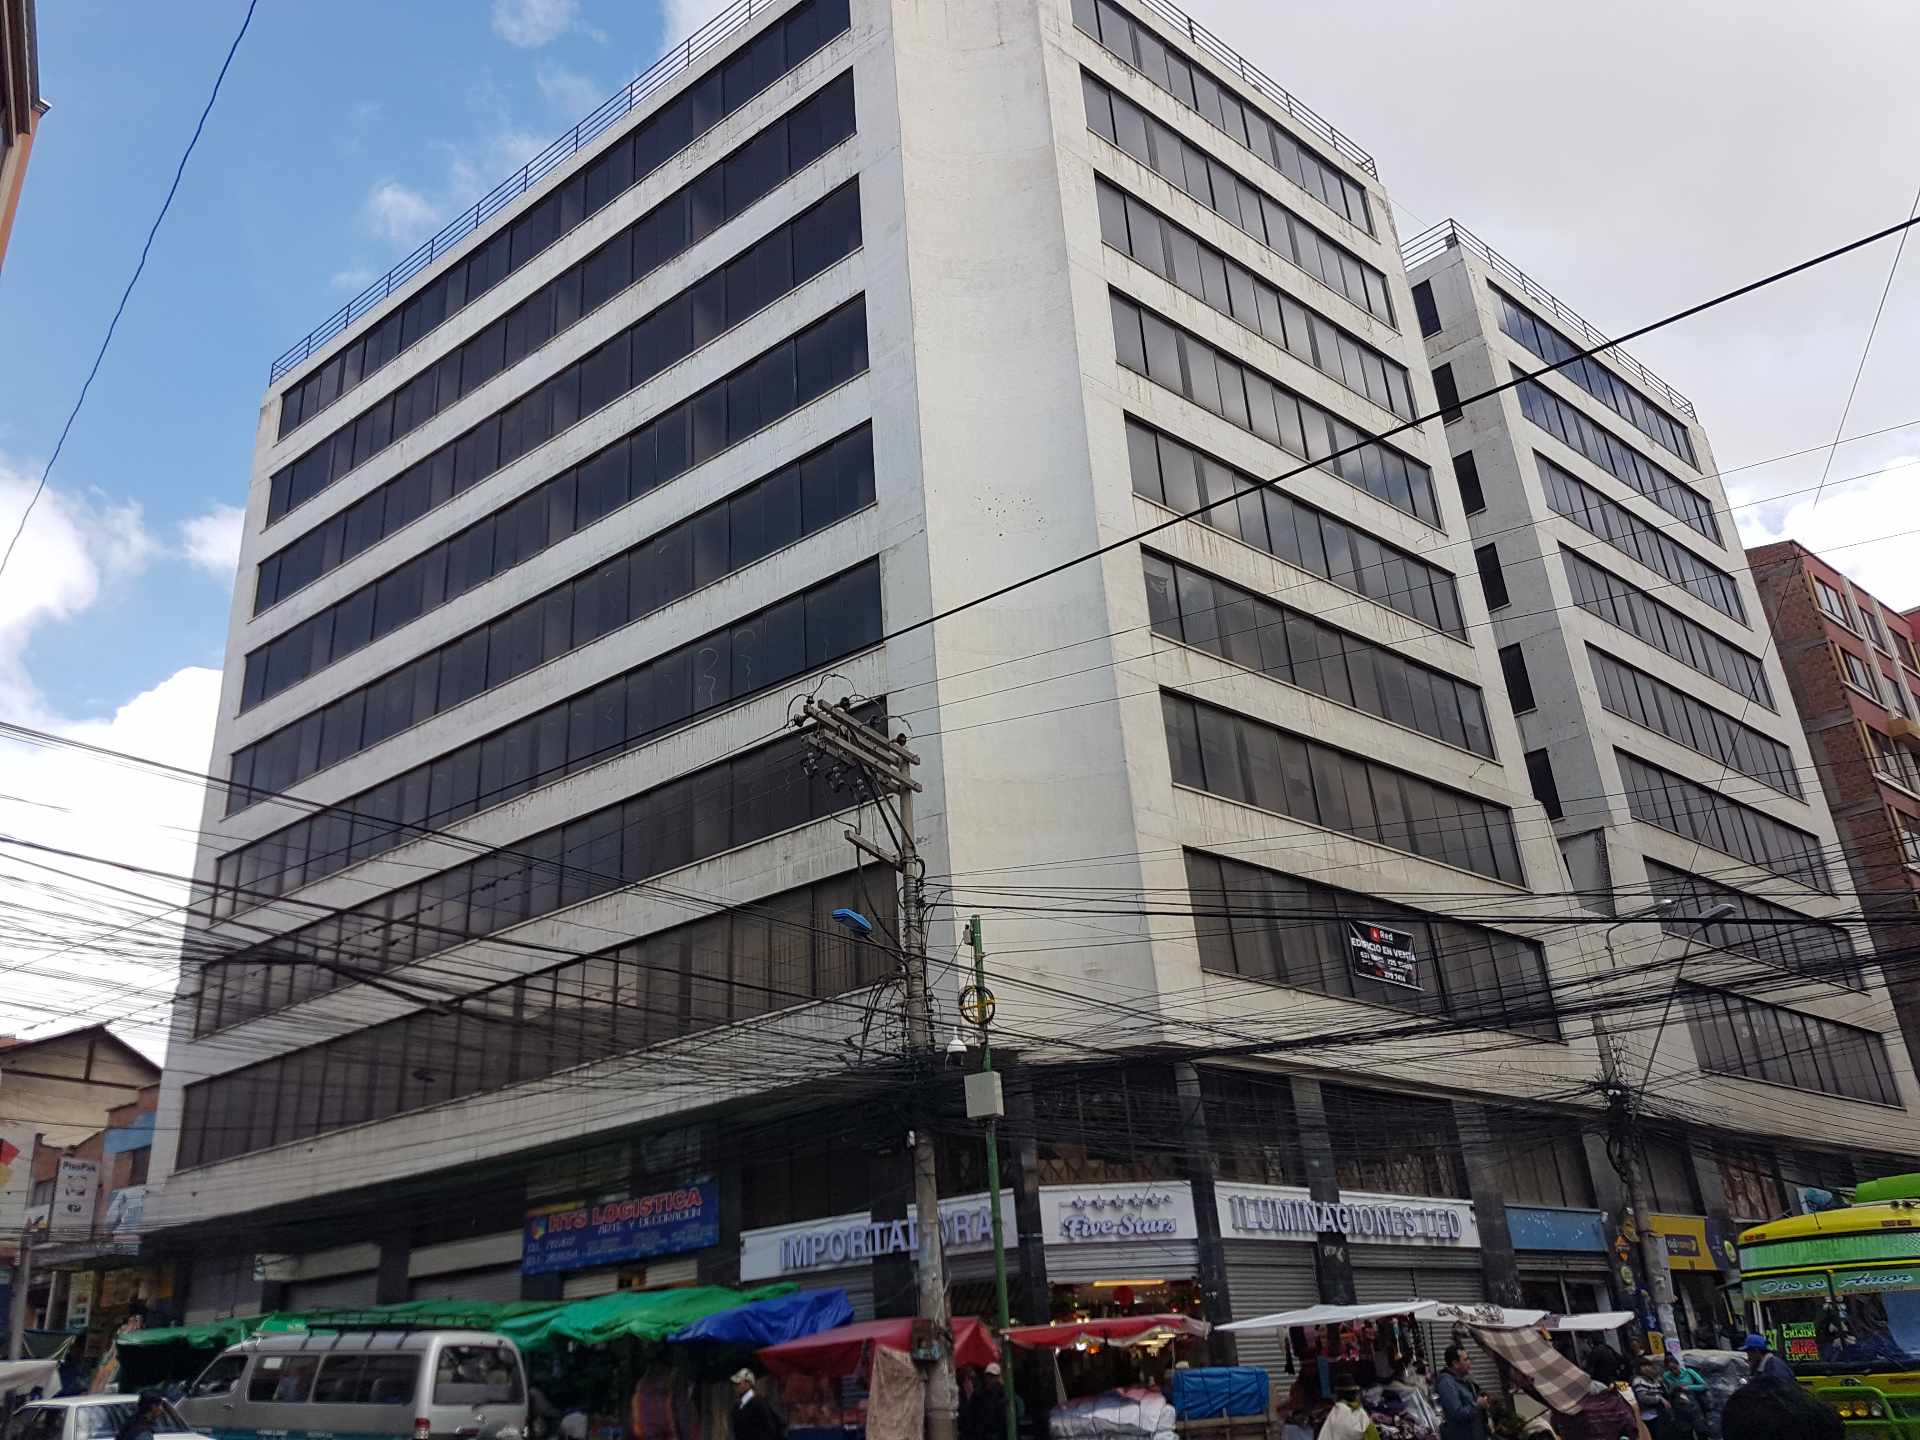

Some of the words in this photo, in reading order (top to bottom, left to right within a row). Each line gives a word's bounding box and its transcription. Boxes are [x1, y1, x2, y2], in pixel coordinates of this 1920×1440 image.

[1351, 937, 1382, 953] EDIFICIO
[1382, 945, 1393, 956] EN
[1392, 948, 1416, 962] VENTA
[592, 1187, 703, 1225] LOGISTICA
[1230, 1194, 1416, 1237] ILUMINACIONES
[1422, 1208, 1463, 1240] LED
[1064, 1215, 1114, 1239] Five
[1120, 1213, 1176, 1236] Stars
[1839, 1272, 1913, 1288] Amor
